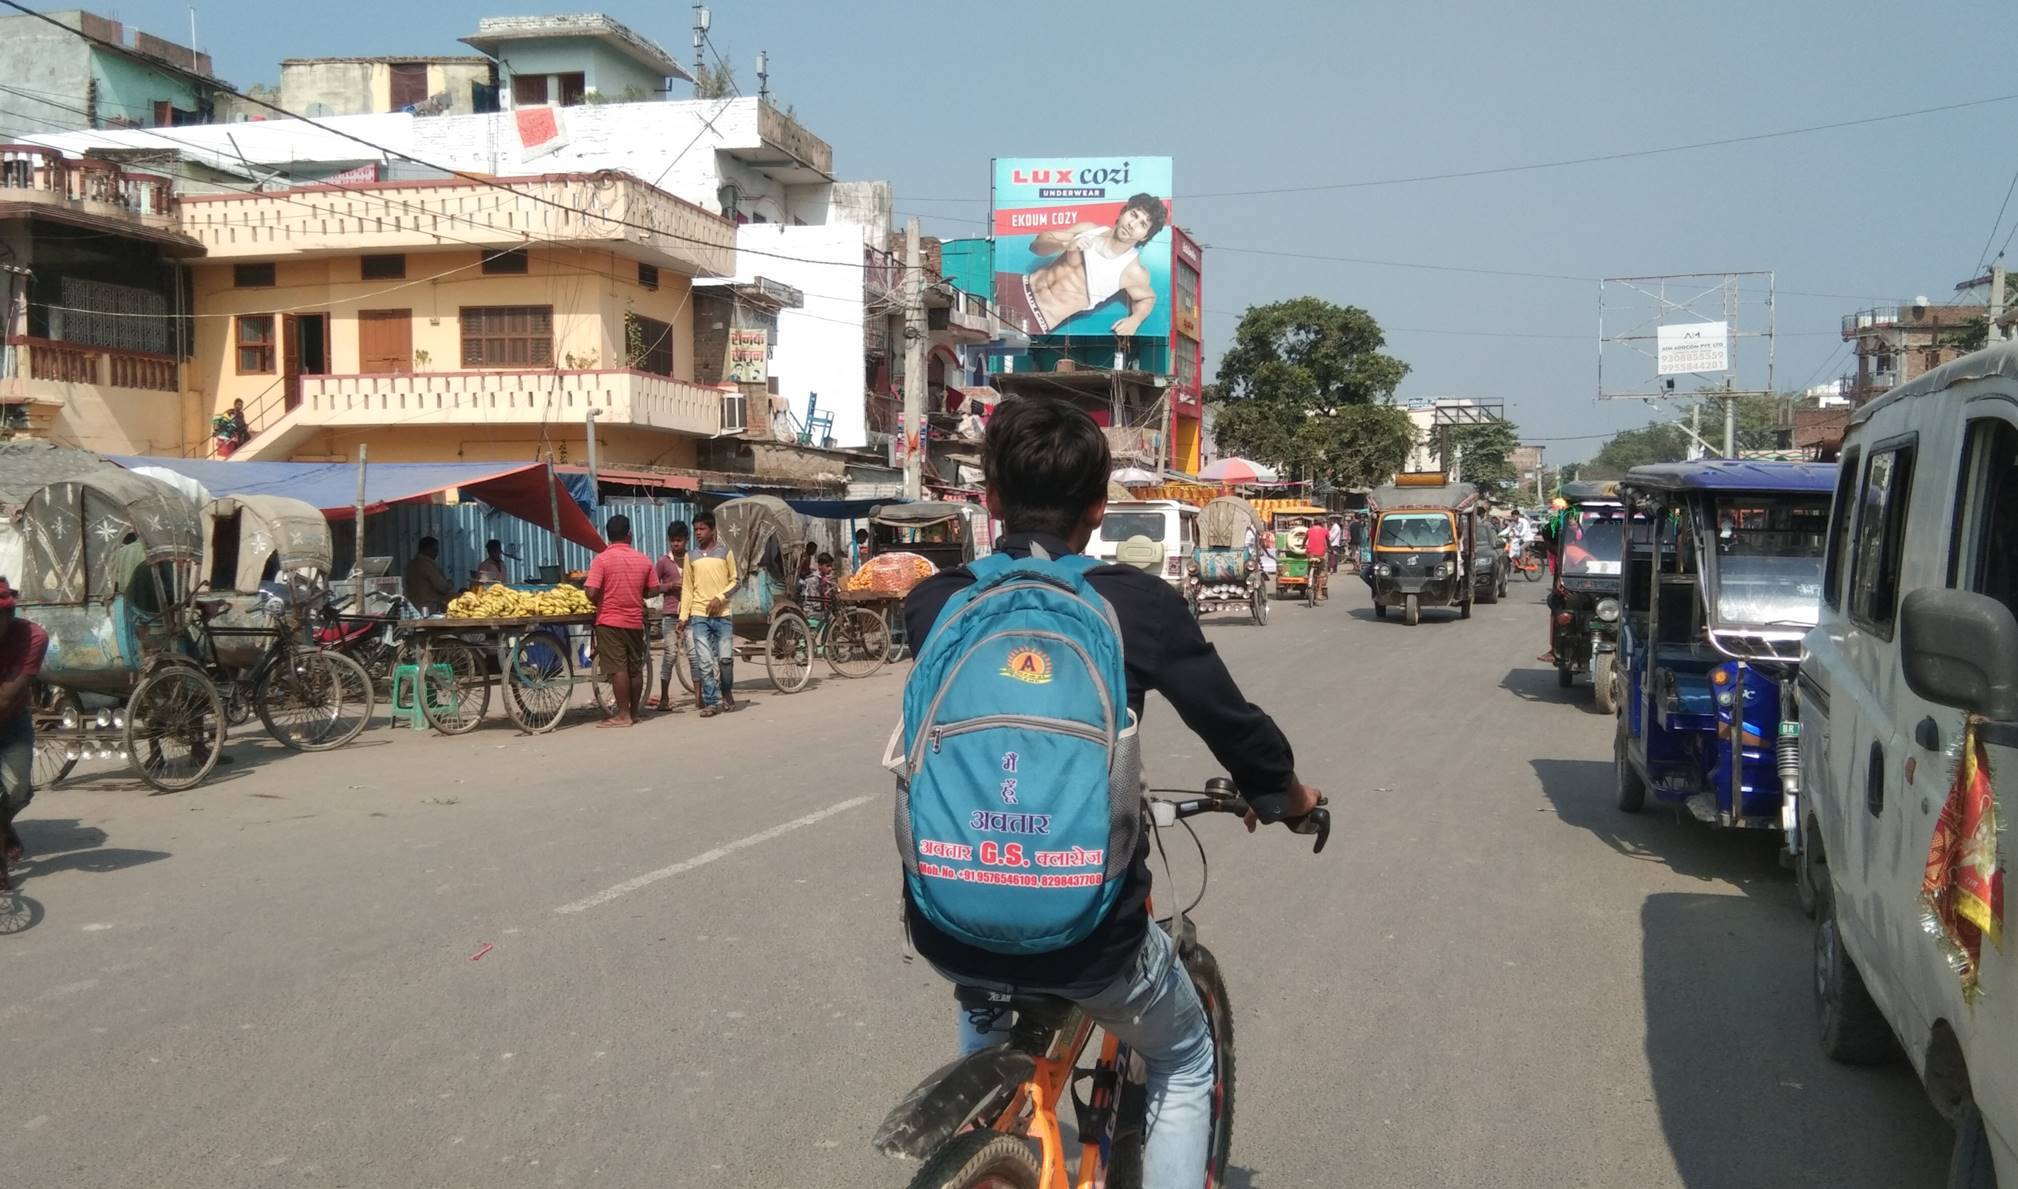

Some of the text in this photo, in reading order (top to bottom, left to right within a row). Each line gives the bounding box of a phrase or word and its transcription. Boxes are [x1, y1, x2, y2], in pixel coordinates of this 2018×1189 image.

[1012, 161, 1131, 185] LUX cozi
[1042, 189, 1101, 197] UNDERWEAR
[1051, 211, 1079, 225] COZY
[1020, 654, 1036, 672] A
[969, 810, 1050, 835] अवतार
[919, 839, 1104, 867] अवतार G.S. क्लासेज
